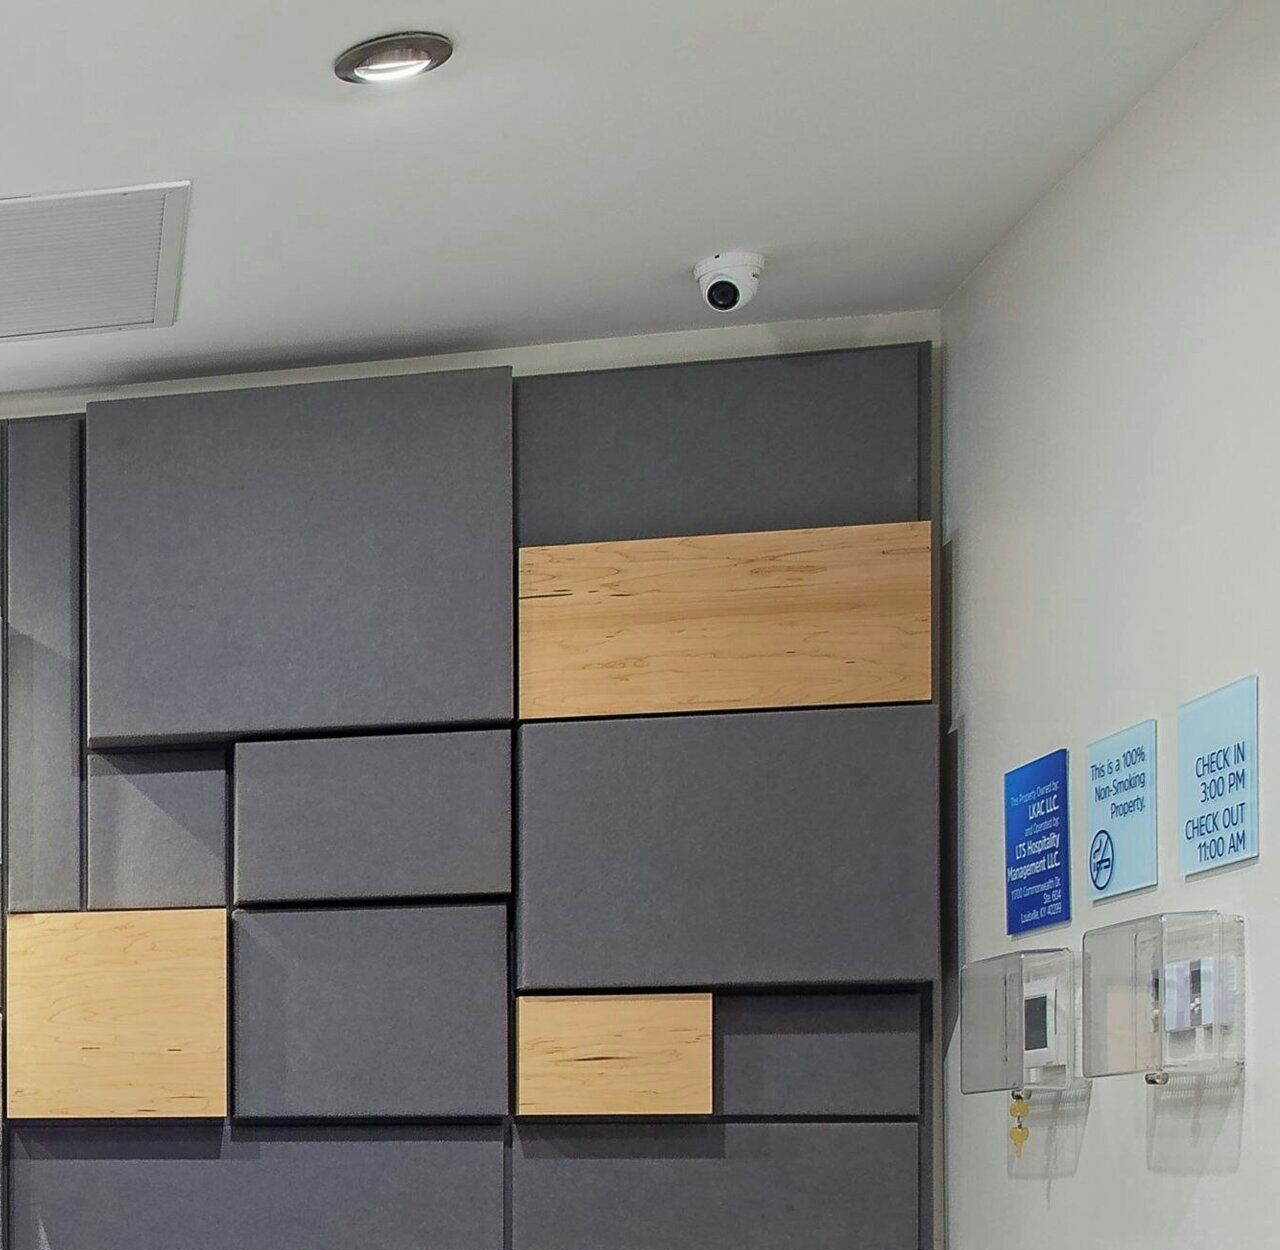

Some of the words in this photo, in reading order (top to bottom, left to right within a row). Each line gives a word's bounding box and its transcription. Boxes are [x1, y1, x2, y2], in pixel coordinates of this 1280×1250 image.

[1090, 762, 1105, 780] This
[1107, 760, 1113, 775] is
[1115, 759, 1120, 772] a
[1122, 745, 1145, 768] 100%
[1195, 746, 1230, 778] CHECK
[1234, 741, 1245, 765] IN
[1095, 772, 1145, 802] Non-Smoking
[1200, 776, 1225, 803] 3:00
[1228, 768, 1246, 794] PM
[1111, 795, 1146, 819] Property.
[1185, 811, 1219, 840] CHECK
[1222, 802, 1246, 829] OUT
[1027, 832, 1060, 856] Hospitality
[1197, 836, 1225, 862] 11:00
[1228, 829, 1246, 854] AM
[1007, 856, 1046, 882] Management
